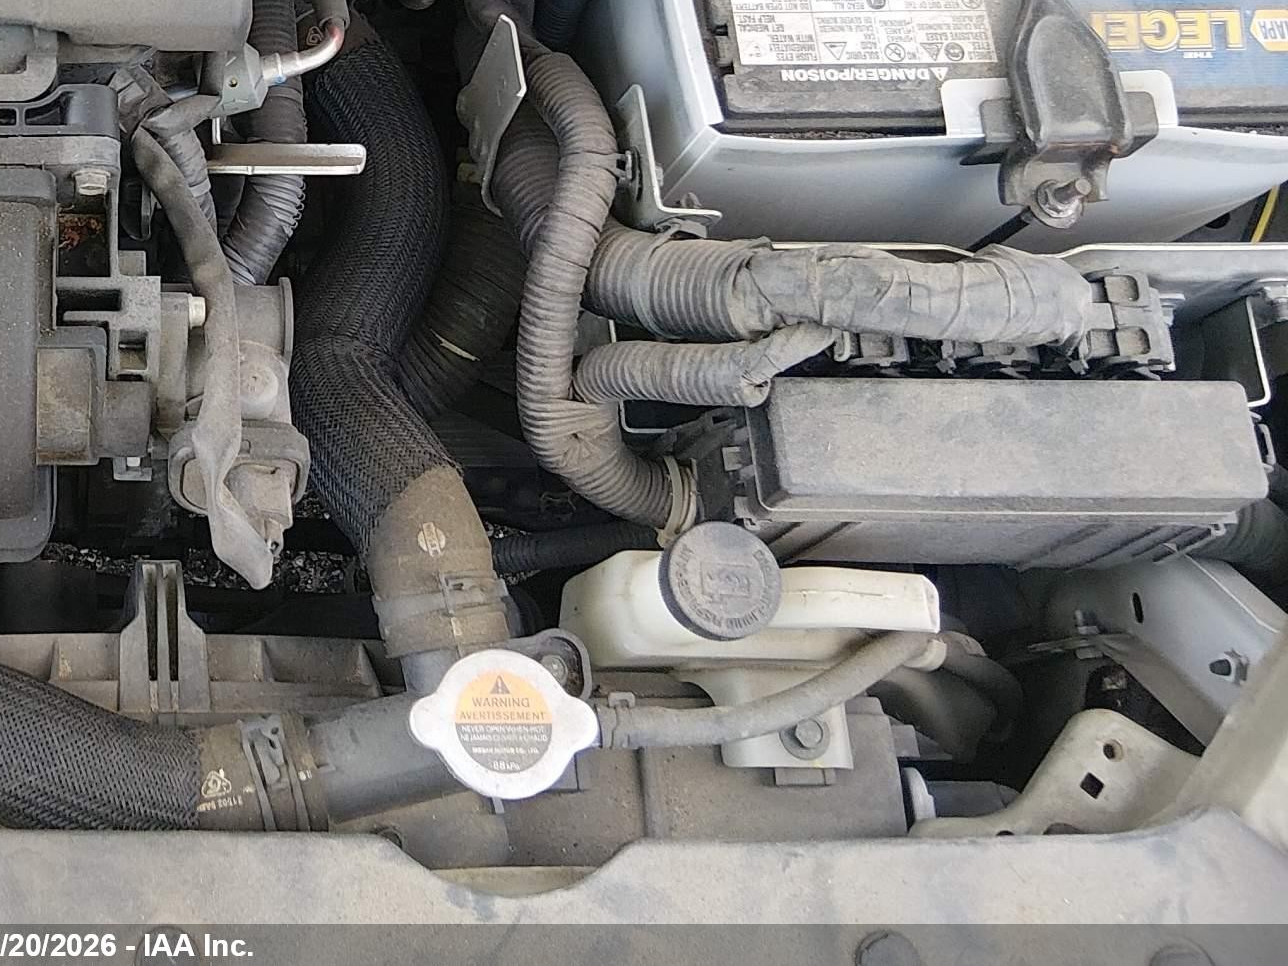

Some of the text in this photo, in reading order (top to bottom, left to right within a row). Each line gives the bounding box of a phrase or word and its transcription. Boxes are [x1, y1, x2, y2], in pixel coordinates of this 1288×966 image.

[796, 34, 814, 42] WITH
[846, 51, 880, 60] SULFURIC
[780, 68, 930, 81] DANGER/POISON
[472, 697, 530, 708] WARNING
[459, 710, 545, 721] AVERTISSEMENT
